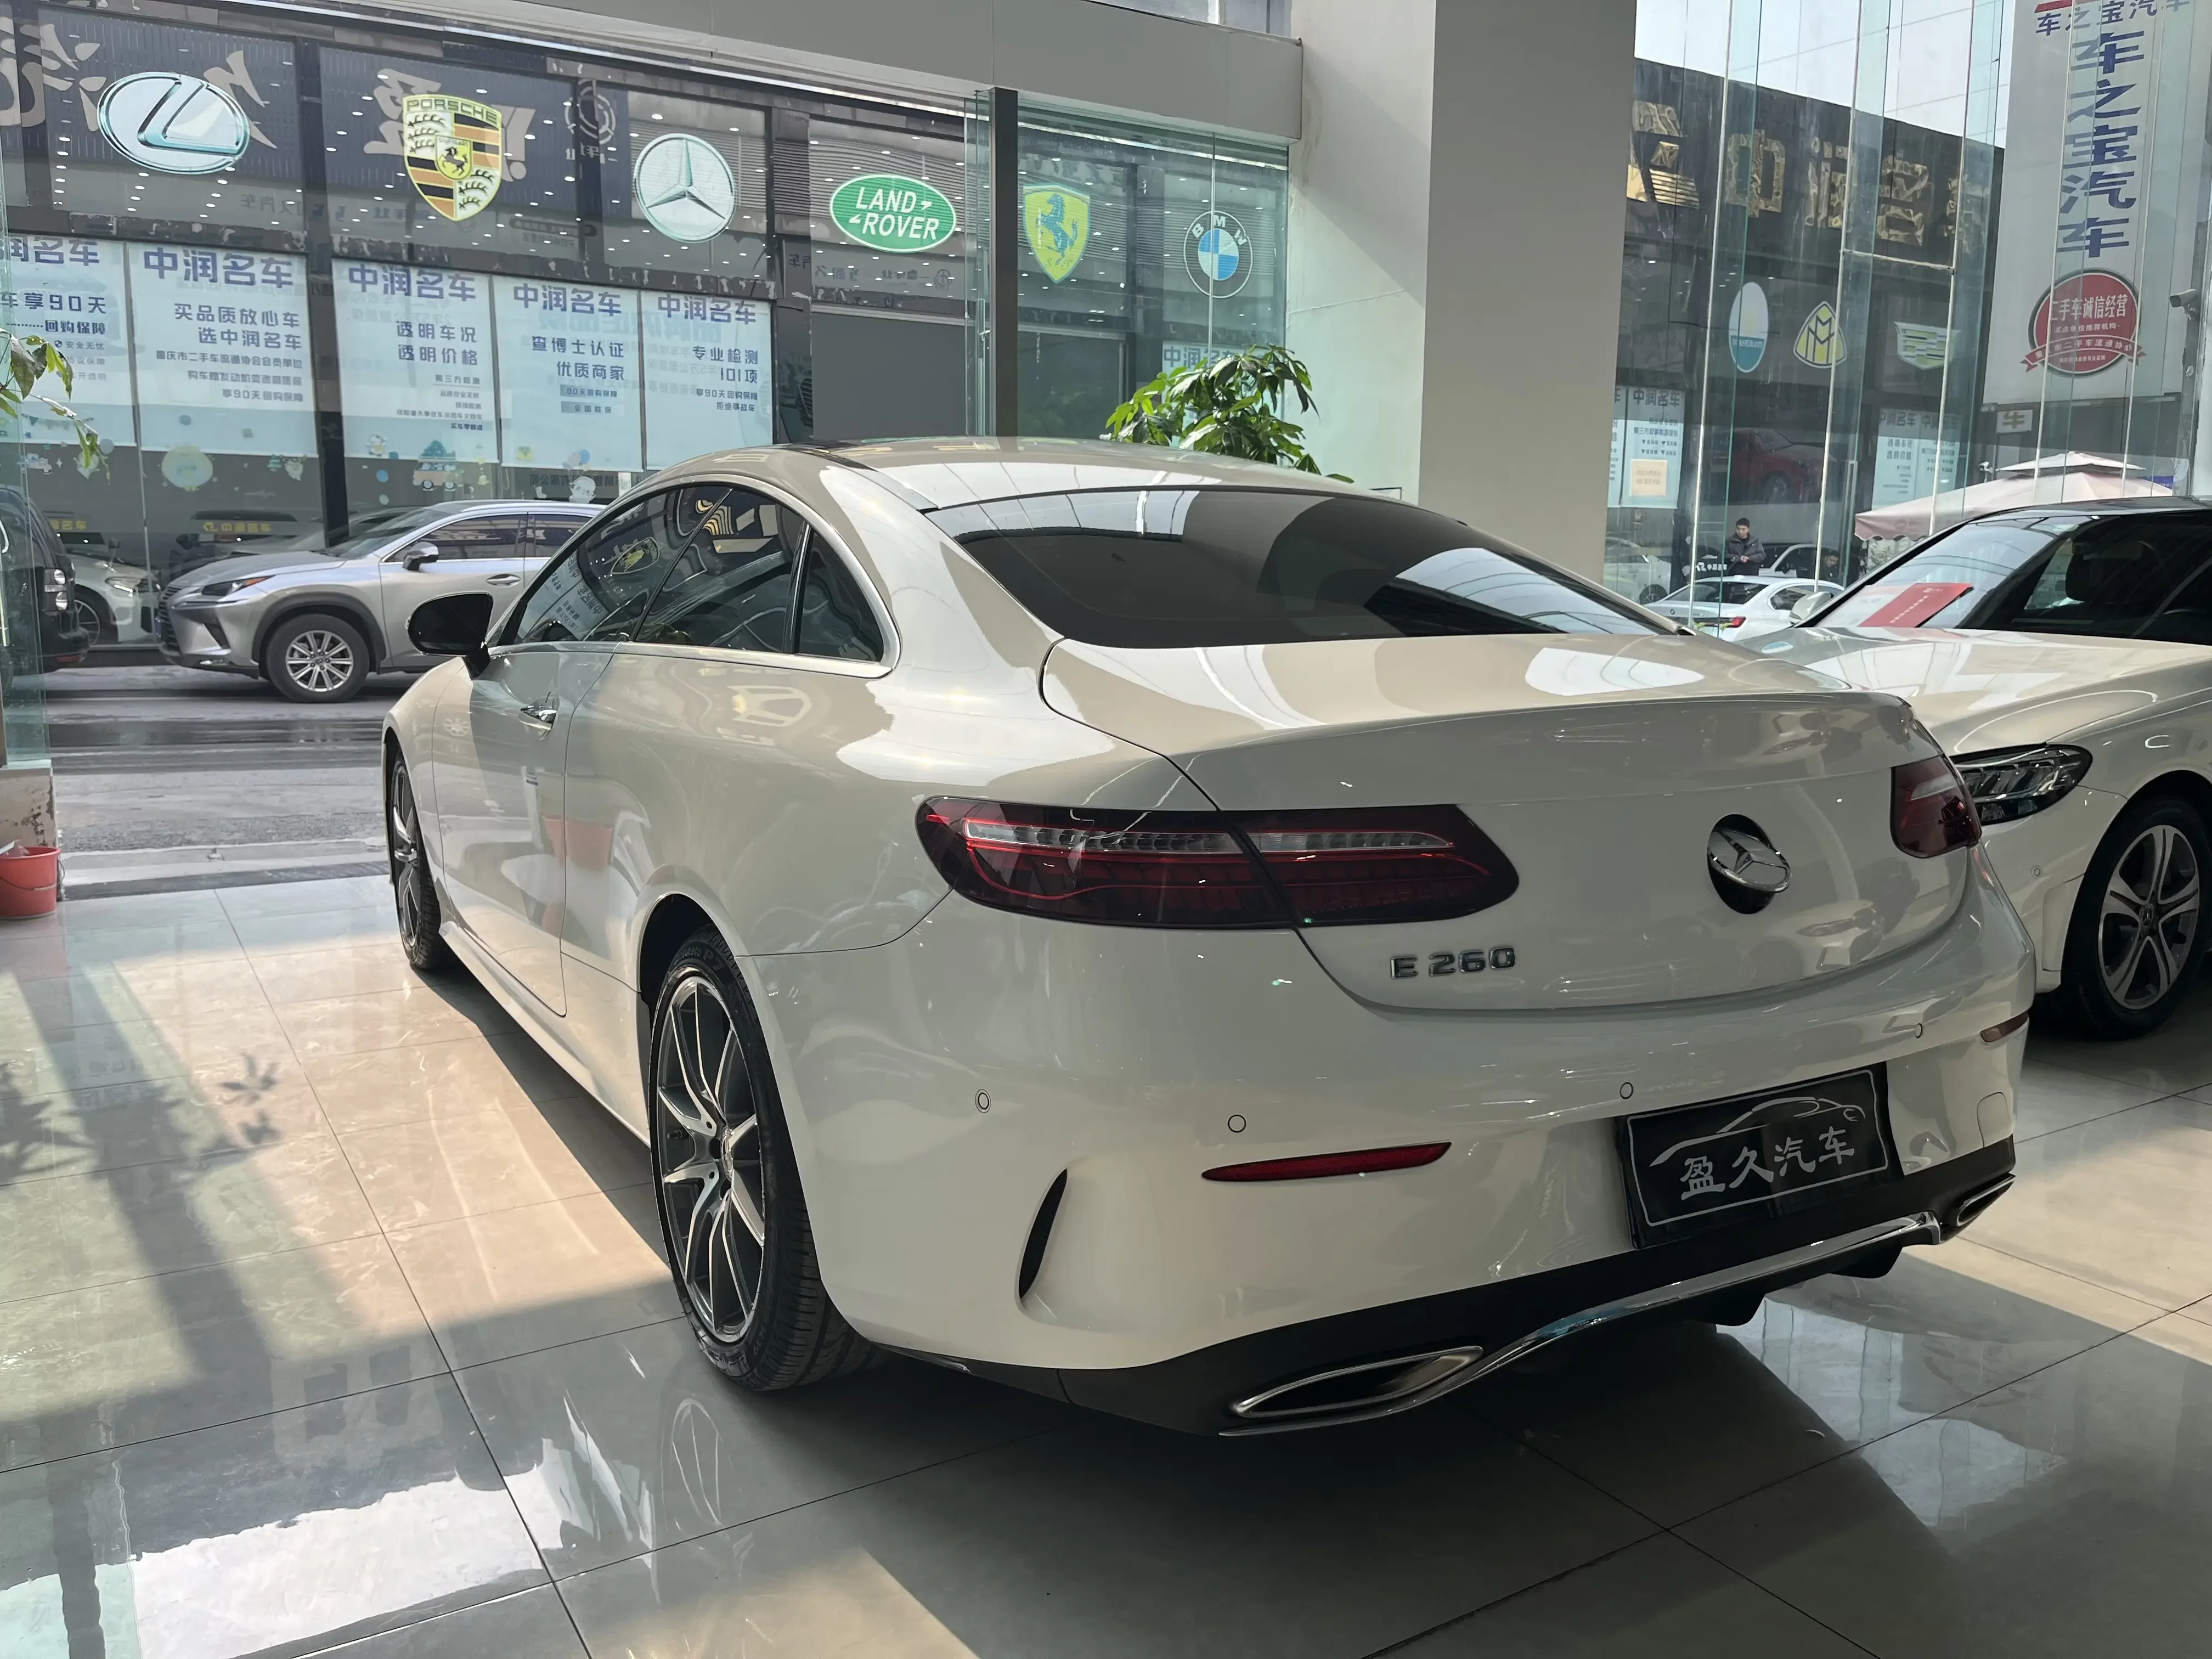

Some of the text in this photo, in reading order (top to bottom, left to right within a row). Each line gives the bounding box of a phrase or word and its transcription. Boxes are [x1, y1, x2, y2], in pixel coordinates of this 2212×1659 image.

[407, 99, 497, 125] PORSCHE
[2057, 31, 2144, 258] 车之宝汽车
[856, 187, 916, 213] LAND
[861, 212, 939, 240] ROVER
[1192, 215, 1247, 246] BMW
[143, 247, 294, 289] 中润名车
[348, 264, 476, 302] 中润名车
[514, 283, 622, 317] 中润名车
[658, 294, 757, 325] 中润名车
[45, 319, 105, 335] 回购保障
[174, 303, 300, 328] 买品质放心车
[199, 327, 302, 350] 选中润名车
[396, 320, 477, 343] 透明车况
[65, 341, 105, 350] 安全无忧
[398, 344, 478, 366] 透明价格
[532, 336, 624, 358] 查博士认证
[692, 346, 758, 365] 专业检测
[2035, 338, 2132, 359] 重市二手车流通协会
[1164, 346, 1234, 369] 中润名
[557, 360, 624, 381] 优质商家
[720, 368, 758, 384] 101项
[696, 388, 758, 400] 享90天回购保障
[1633, 389, 1680, 407] 中润名车
[716, 401, 755, 412] 拒绝事故车
[1390, 946, 1516, 980] E 260
[1680, 1126, 1855, 1200] 盈久汽车
